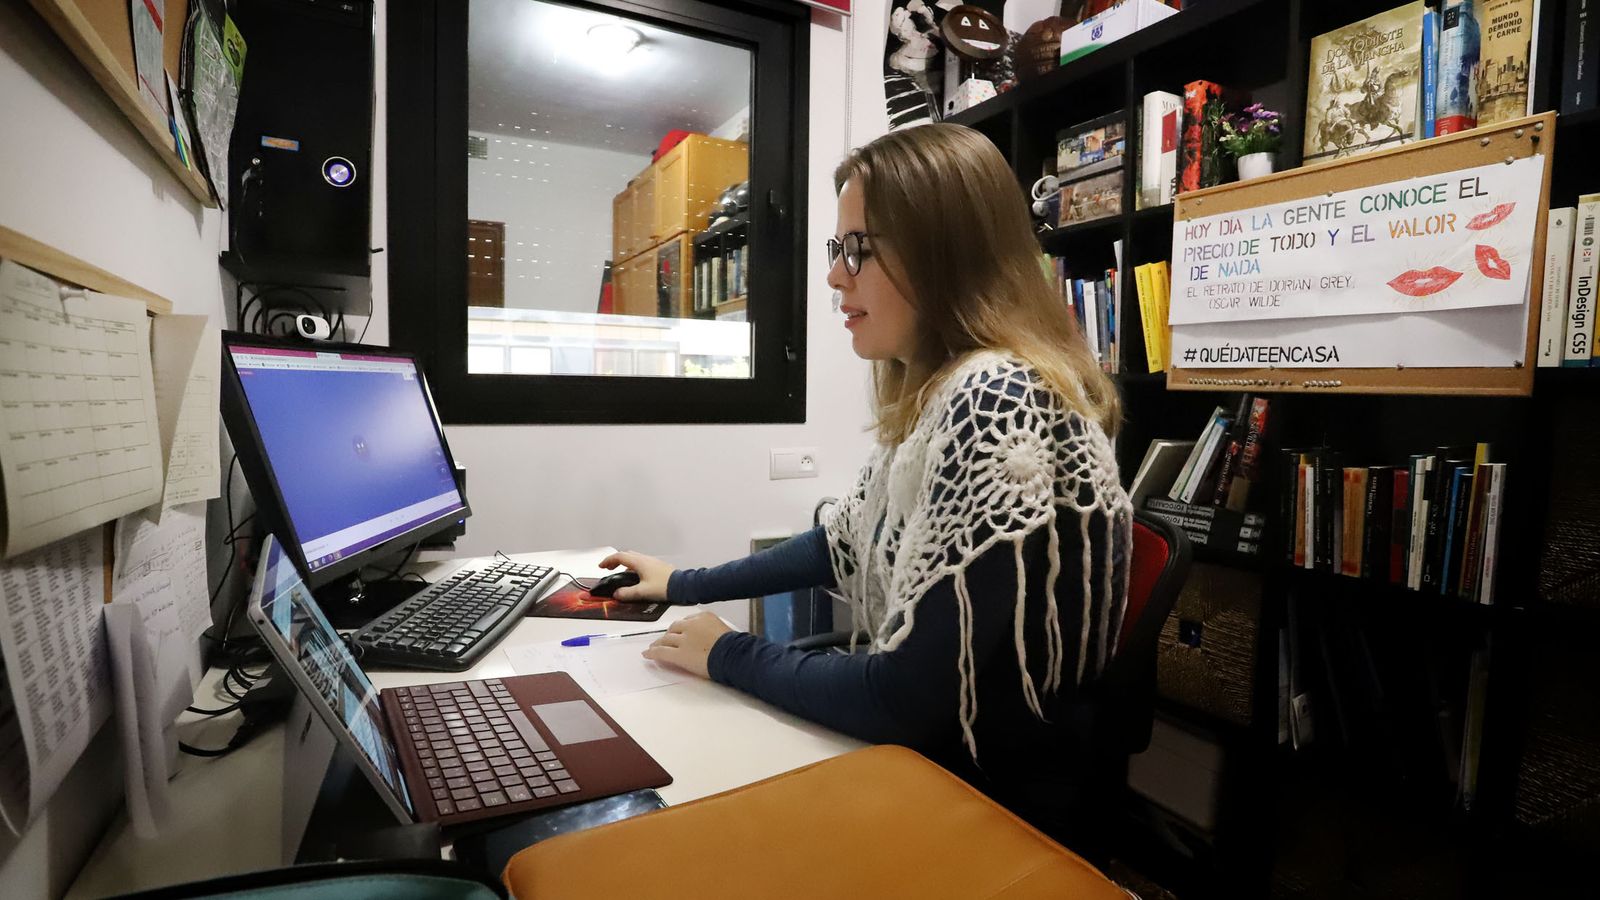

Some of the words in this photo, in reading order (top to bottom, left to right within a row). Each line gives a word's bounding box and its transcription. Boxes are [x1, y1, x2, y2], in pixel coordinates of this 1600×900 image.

[1488, 17, 1523, 34] DEMONIO
[1491, 11, 1519, 25] MUNDO
[1353, 27, 1404, 52] QUIJOTE
[1496, 26, 1521, 39] CARNE
[1337, 57, 1352, 70] LA
[1353, 41, 1406, 67] MANCHA
[1184, 222, 1212, 241] HOY
[1252, 213, 1273, 231] LA
[1283, 200, 1346, 226] GENTE
[1360, 182, 1449, 214] CONOCE
[1458, 176, 1489, 200] EL
[1183, 242, 1235, 263] PRECIO
[1237, 238, 1261, 257] DE
[1270, 232, 1316, 253] TODO
[1327, 228, 1340, 247] Y
[1351, 224, 1376, 244] EL
[1388, 213, 1457, 240] VALOR
[1189, 264, 1210, 281] DE
[1217, 258, 1261, 278] NADA
[1186, 286, 1198, 298] EL
[1203, 281, 1245, 296] RETRATO
[1249, 280, 1263, 293] DE
[1268, 278, 1312, 292] DORIAN
[1208, 296, 1241, 310] OSCAR
[1249, 294, 1281, 308] WILDE
[1571, 276, 1593, 329] InDesign
[1571, 332, 1588, 355] CS5
